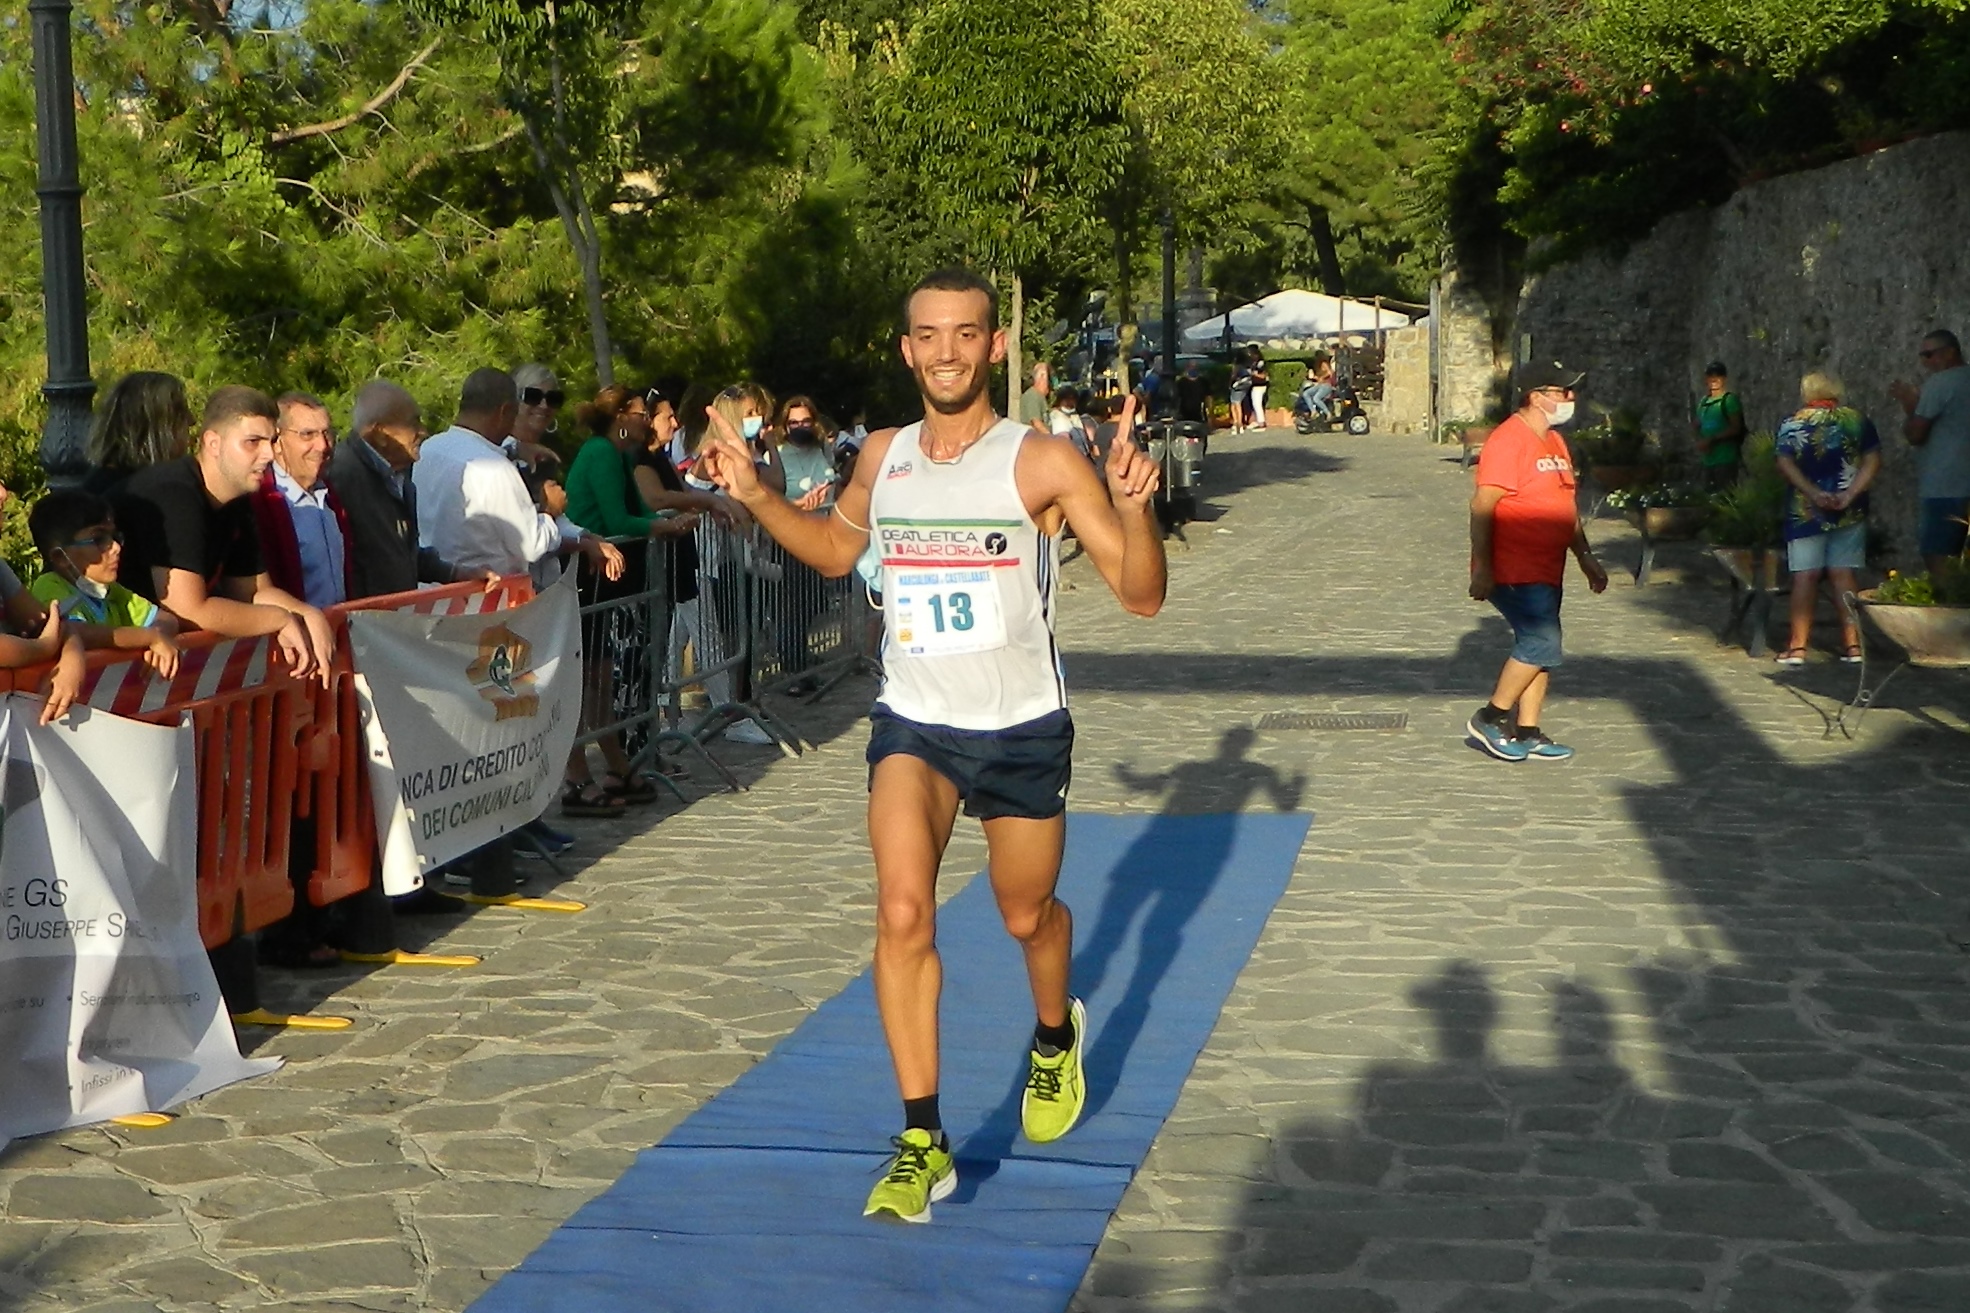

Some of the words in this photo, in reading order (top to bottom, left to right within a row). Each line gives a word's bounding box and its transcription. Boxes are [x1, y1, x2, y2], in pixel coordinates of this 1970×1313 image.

[905, 544, 986, 557] AURORA
[928, 592, 975, 633] 13
[439, 763, 458, 791] DI
[462, 742, 526, 785] CREDITO
[422, 807, 447, 840] DEI
[450, 785, 512, 828] COMUNI
[24, 878, 69, 907] GS
[6, 914, 97, 941] GIUSEPPE
[81, 1069, 113, 1093] Infissi
